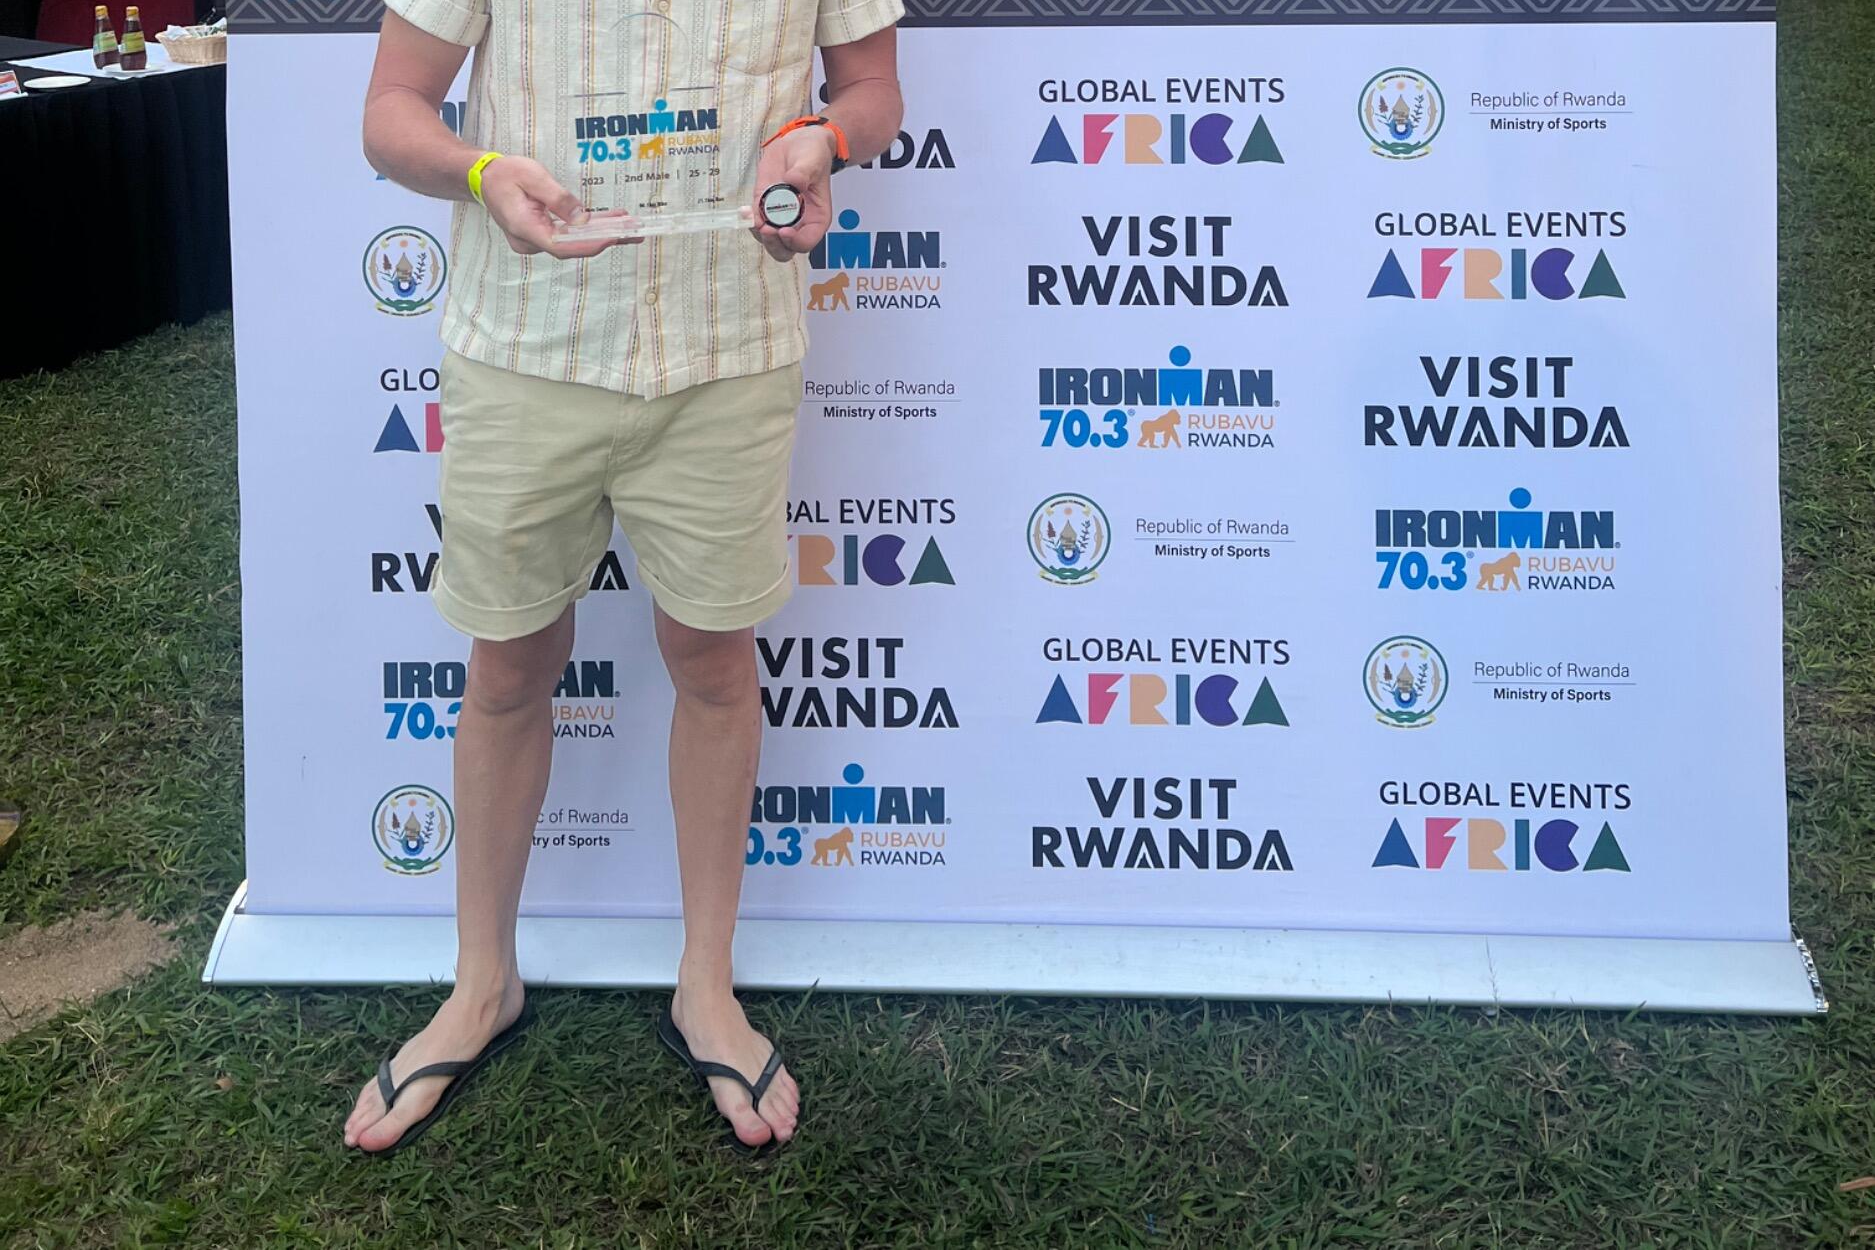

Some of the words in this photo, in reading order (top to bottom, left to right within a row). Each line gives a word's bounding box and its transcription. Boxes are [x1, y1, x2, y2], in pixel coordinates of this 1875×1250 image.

[1039, 79, 1156, 103] GLOBAL
[1167, 77, 1285, 103] EVENTS
[1471, 92, 1539, 110] Republic
[1542, 91, 1559, 108] of
[1563, 91, 1625, 108] Rwanda
[575, 99, 718, 139] IRONMAN
[1489, 118, 1545, 134] Ministry
[1546, 118, 1560, 130] of
[1561, 118, 1607, 132] Sports
[577, 138, 632, 163] 70.3
[669, 145, 720, 156] RWANDA
[1031, 113, 1285, 166] AFRICA
[581, 177, 604, 186] 2023
[625, 174, 643, 183] 2nd
[646, 171, 670, 182] Male
[689, 169, 700, 178] 25
[709, 167, 720, 177] 29
[1081, 215, 1232, 258] VISIT
[1375, 212, 1496, 237] GLOBAL
[1508, 211, 1626, 238] EVENTS
[857, 276, 940, 291] RUBAVU
[1028, 264, 1289, 306] RWANDA
[1367, 248, 1626, 300] AFRICA
[857, 295, 941, 309] RWANDA
[803, 378, 870, 400] Republic
[875, 379, 890, 396] of
[895, 380, 956, 396] Rwanda
[1039, 345, 1276, 410] IRONMAN
[1420, 356, 1573, 398] VISIT
[823, 406, 875, 420] Ministry
[879, 406, 891, 418] of
[894, 407, 938, 420] Sports
[1188, 414, 1274, 430] RUBAVU
[1040, 409, 1131, 448] 70.3
[1364, 405, 1630, 449] RWANDA
[1188, 433, 1274, 448] RWANDA
[840, 499, 955, 524] EVENTS
[1376, 487, 1617, 552] IRONMAN
[1137, 518, 1202, 538] Republic
[1207, 518, 1222, 534] of
[1227, 519, 1288, 535] Rwanda
[787, 534, 956, 586] RICA
[1154, 544, 1208, 560] Ministry
[1211, 544, 1224, 557] of
[1226, 544, 1271, 560] Sports
[1376, 551, 1470, 591] 70.3
[1529, 557, 1614, 573] RUBAVU
[1528, 576, 1615, 590] RWANDA
[756, 637, 904, 679] VISIT
[1044, 638, 1161, 662] GLOBAL
[1172, 638, 1290, 666] EVENTS
[1475, 662, 1542, 679] Republic
[1547, 662, 1562, 678] of
[1567, 662, 1629, 677] Rwanda
[760, 687, 960, 728] WANDA
[1035, 673, 1290, 727] AFRICA
[1493, 687, 1549, 702] Ministry
[1550, 688, 1565, 701] of
[1566, 688, 1611, 703] Sports
[552, 705, 615, 721] BAVU
[553, 724, 615, 738] ANDA
[750, 763, 945, 825] ONMAN
[1086, 777, 1237, 821] VISIT
[1379, 781, 1500, 806] GLOBAL
[1511, 782, 1632, 810] EVENTS
[549, 808, 563, 823] of
[569, 809, 628, 824] Rwanda
[552, 834, 565, 846] of
[568, 834, 610, 849] Sports
[745, 827, 802, 866] 0.3
[861, 832, 945, 848] RUBAVU
[1032, 826, 1294, 872] RWANDA
[1372, 817, 1631, 873] AFRICA
[861, 851, 945, 866] RWANDA
